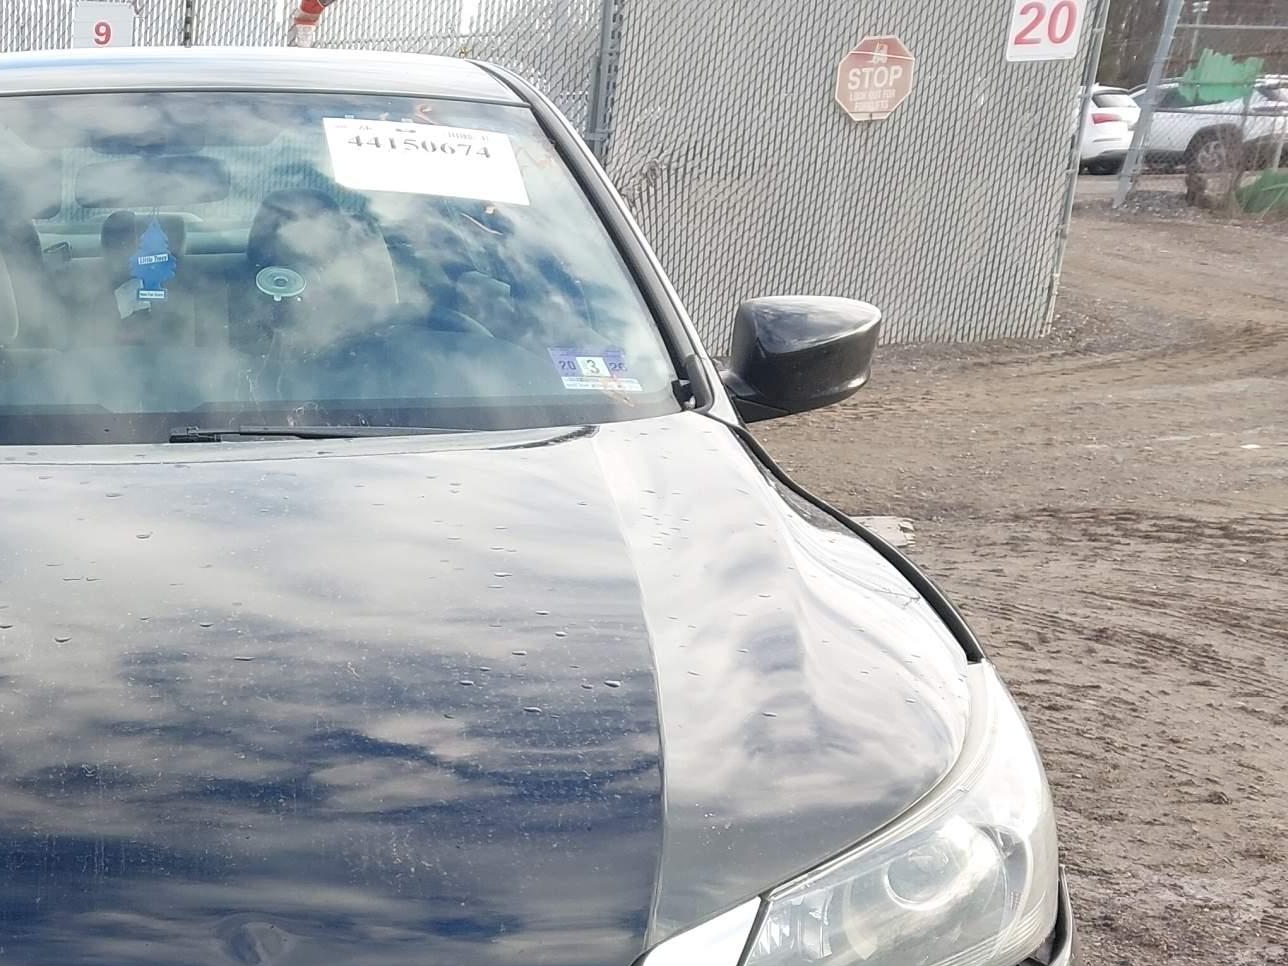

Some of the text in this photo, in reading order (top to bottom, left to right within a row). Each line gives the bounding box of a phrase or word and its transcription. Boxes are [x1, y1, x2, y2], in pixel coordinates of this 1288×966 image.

[94, 21, 112, 46] 9
[1014, 0, 1077, 45] 20
[847, 65, 903, 90] STOP
[348, 134, 491, 160] 44150674
[586, 359, 600, 374] 3
